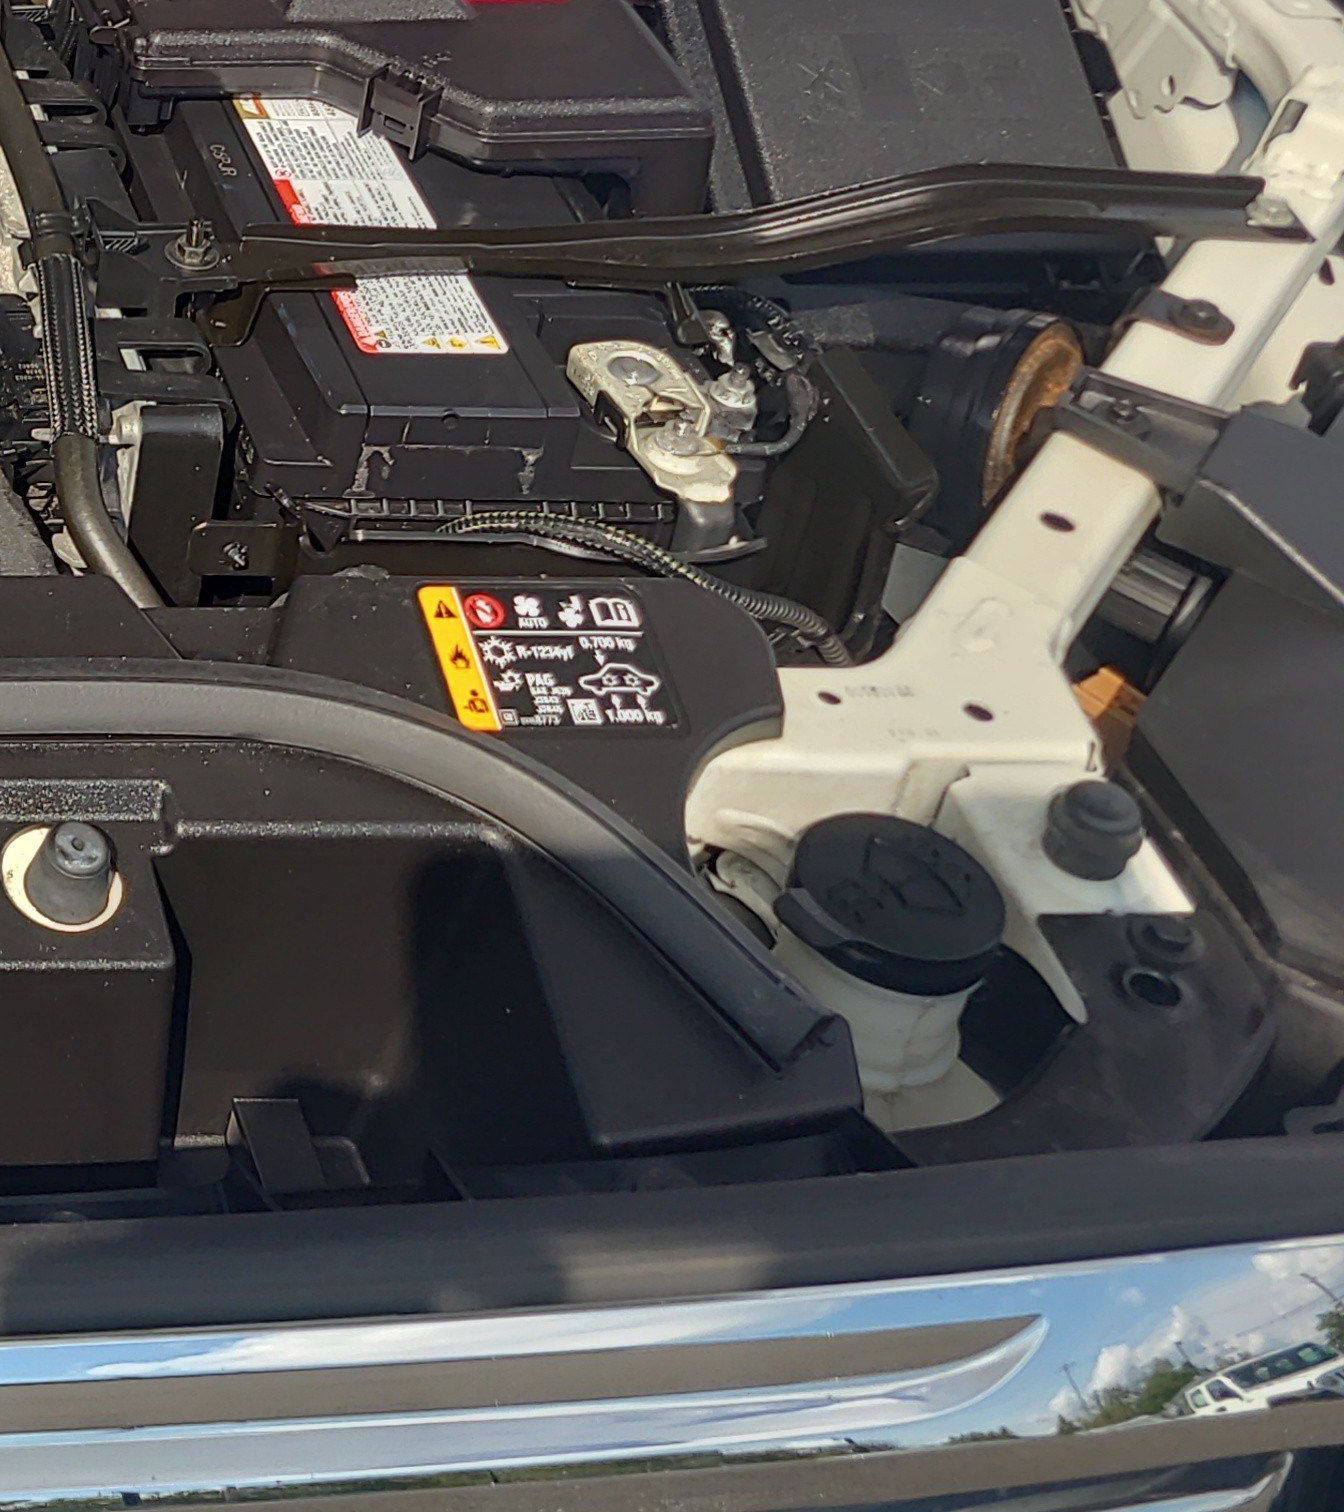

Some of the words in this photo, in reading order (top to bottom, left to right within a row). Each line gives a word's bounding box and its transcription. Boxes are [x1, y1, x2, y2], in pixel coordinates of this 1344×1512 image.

[517, 616, 549, 630] AUTO
[615, 636, 638, 653] kg
[525, 672, 556, 687] PAG
